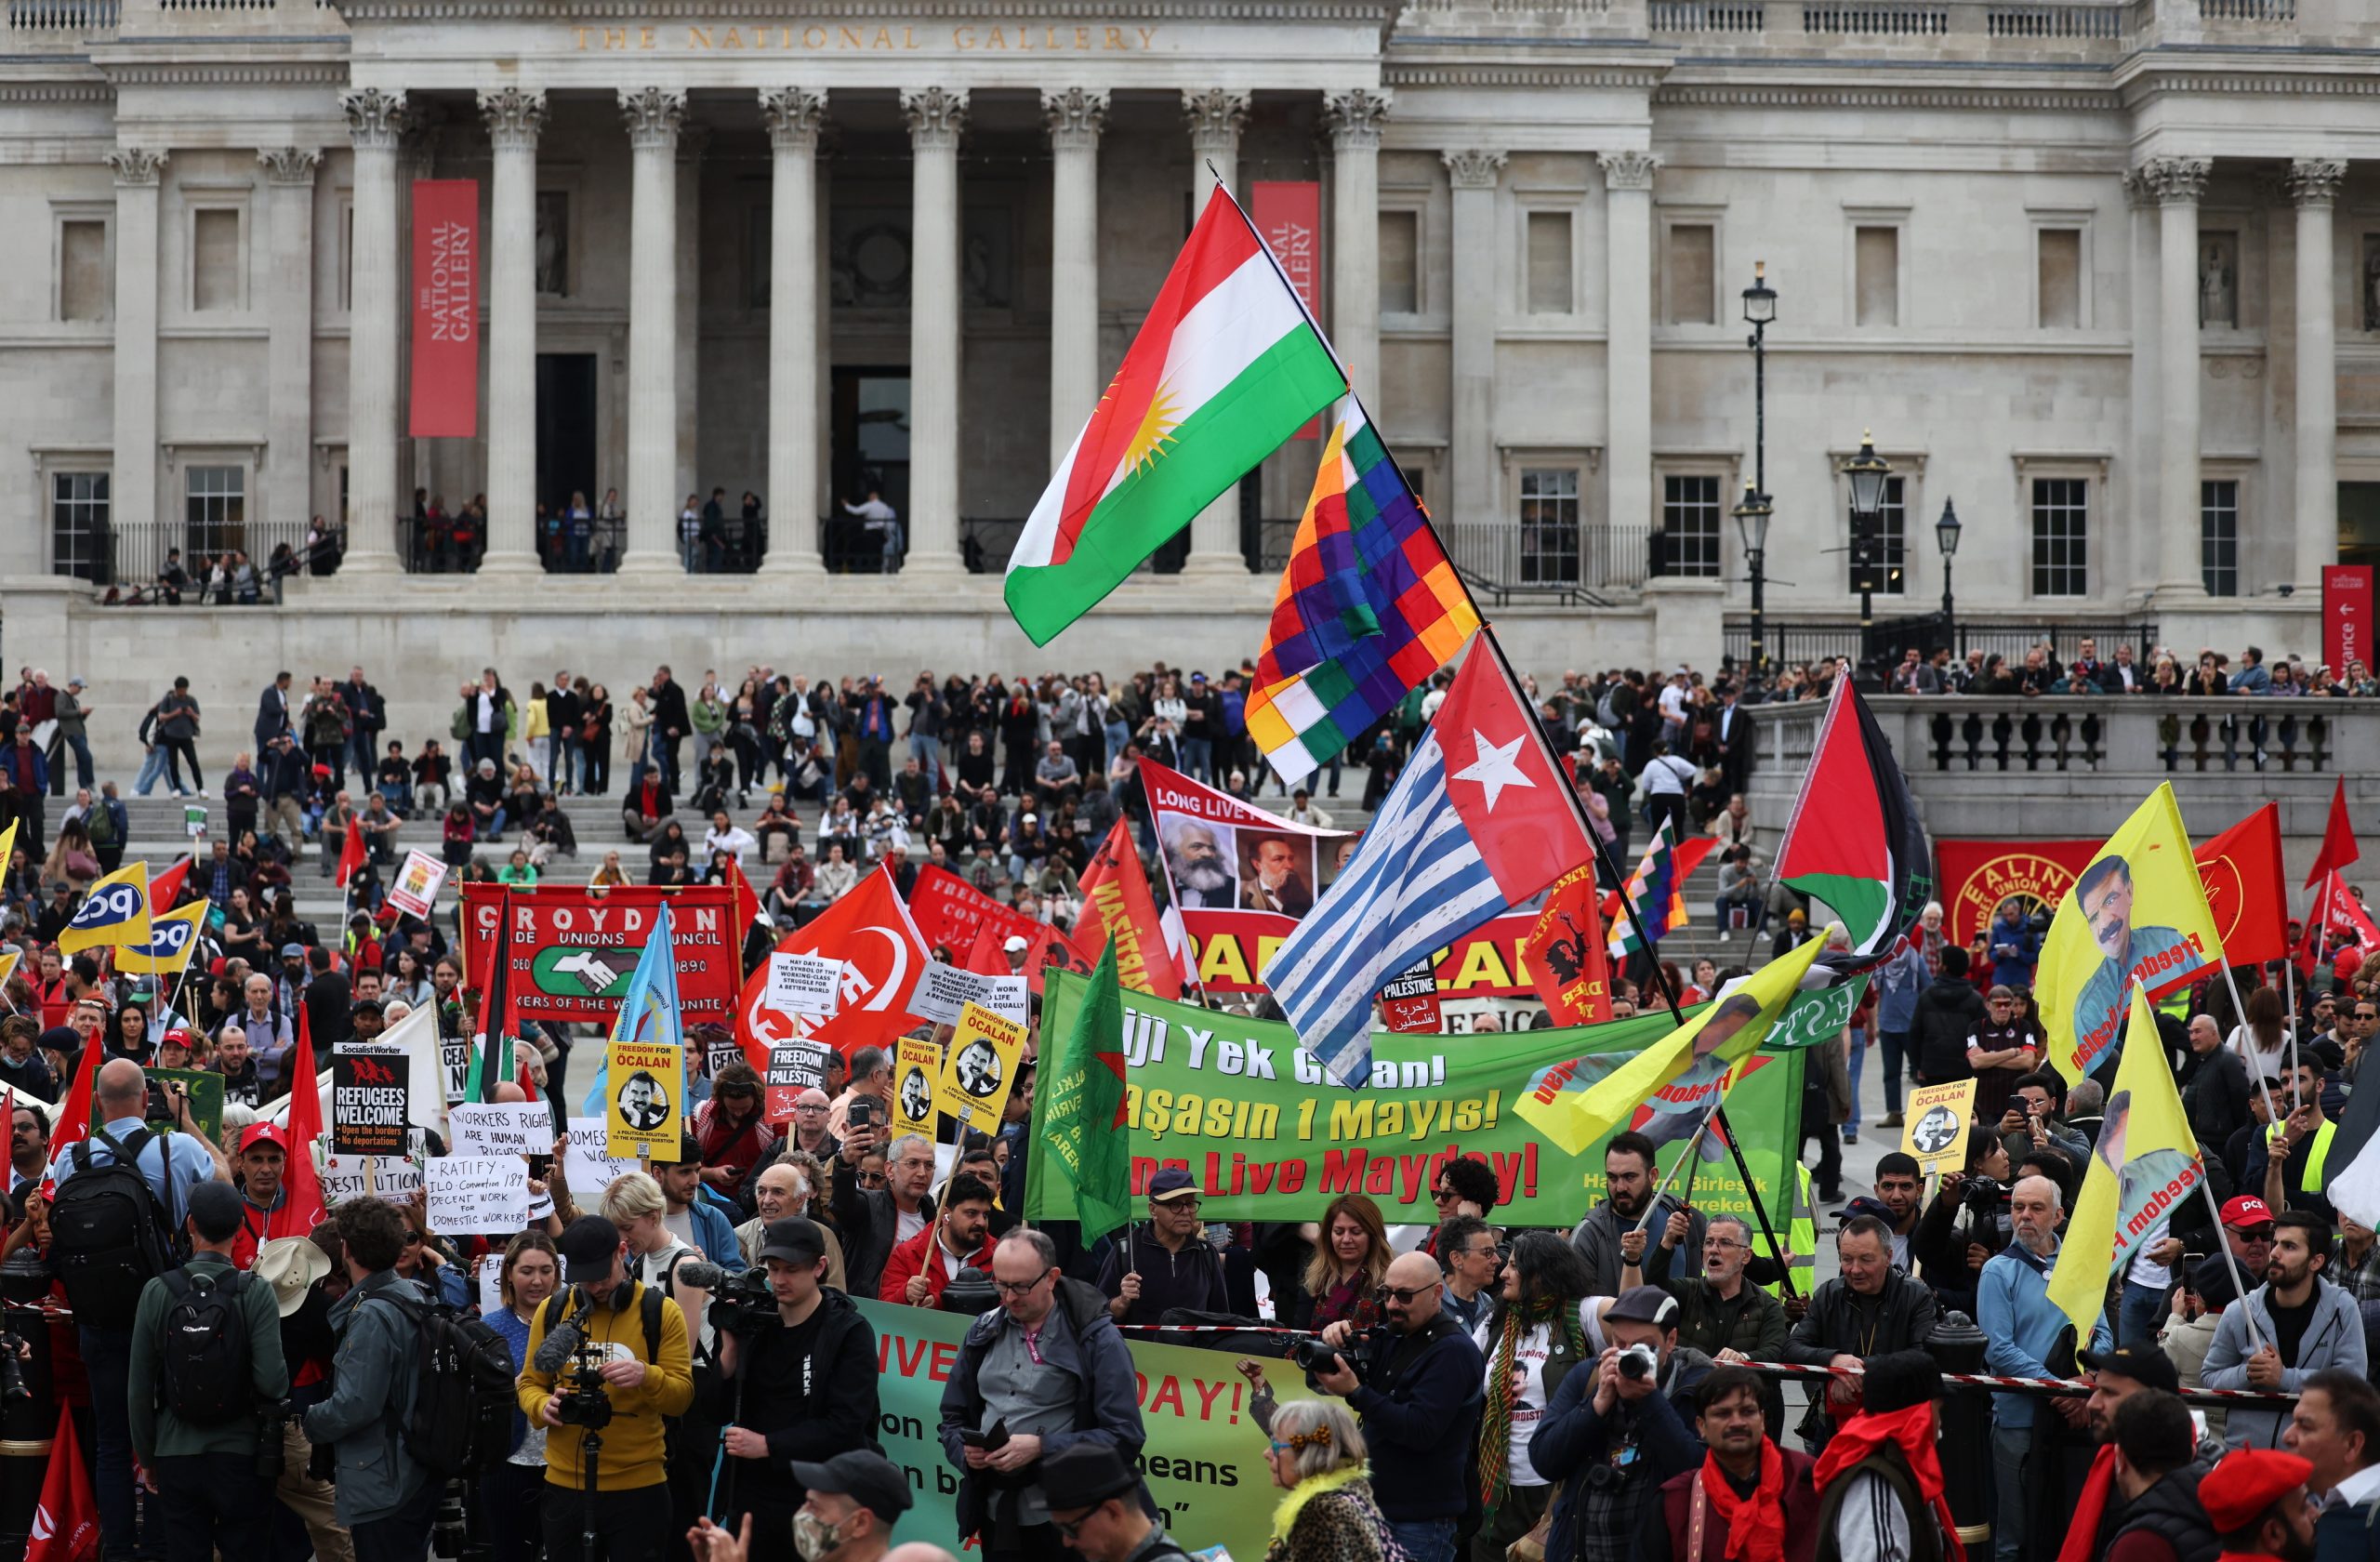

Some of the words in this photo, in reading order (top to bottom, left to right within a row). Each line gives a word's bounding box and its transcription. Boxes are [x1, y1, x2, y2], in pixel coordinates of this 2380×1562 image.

[569, 25, 656, 50] THE
[688, 25, 921, 50] NATIONAL
[951, 25, 1158, 50] GALLERY
[430, 220, 449, 341] NATIONAL
[449, 221, 470, 342] GALLERY
[2341, 623, 2355, 679] rance
[1156, 788, 1201, 812] LONG
[1964, 859, 2072, 907] EALIN
[1974, 894, 1995, 933] ADES
[1994, 878, 2042, 896] UNION
[558, 931, 625, 946] UNIONS
[675, 960, 707, 973] 1890
[789, 966, 814, 974] SYMBOL
[780, 971, 831, 982] WORKING-CLASS
[783, 977, 813, 986] STRUGGLE
[943, 970, 957, 979] MAY
[958, 973, 971, 983] DAY
[1404, 973, 1415, 982] for
[808, 986, 829, 995] WORLD
[931, 979, 983, 999] WORKING-CLASS
[931, 986, 964, 1000] STRUGGLE
[942, 976, 967, 988] SYMBOL
[976, 986, 989, 995] THE
[1383, 978, 1436, 999] PALESTINE
[555, 996, 573, 1009] OF
[579, 998, 606, 1012] THE
[931, 993, 955, 1005] BETTER
[1395, 999, 1429, 1015] الحرية
[972, 1006, 1005, 1027] FREEDOM
[1004, 1022, 1020, 1034] FOR
[1395, 1013, 1436, 1031] لفلسطين
[968, 1013, 1016, 1047] ÖCALAN
[341, 1044, 373, 1054] Socialist
[374, 1045, 401, 1055] Worker
[617, 1044, 654, 1054] FREEDOM
[654, 1047, 671, 1055] FOR
[802, 1041, 822, 1052] Worker
[903, 1040, 925, 1052] FREEDOM
[925, 1044, 935, 1053] FOR
[616, 1052, 671, 1069] ÖCALAN
[774, 1050, 823, 1068] FREEDOM
[902, 1049, 934, 1066] ÖCALAN
[1182, 1025, 1276, 1081] Yek
[1293, 1047, 1446, 1090] Gan!
[794, 1063, 803, 1071] for
[769, 1070, 824, 1090] PALESTINE
[1918, 1085, 1951, 1096] FREEDOM
[1952, 1081, 1967, 1091] FOR
[336, 1086, 405, 1107] REFUGEES
[951, 1087, 973, 1101] POLITICAL
[972, 1096, 993, 1110] SOLUTION
[1915, 1090, 1966, 1107] ÖCALAN
[336, 1105, 404, 1126] WELCOME
[451, 1111, 510, 1128] WORKERS
[519, 1112, 553, 1130] RIGHTS
[1126, 1082, 1280, 1141] aşasın
[1297, 1097, 1314, 1141] 1
[1329, 1089, 1501, 1142] Mayıs!
[341, 1125, 360, 1135] Open
[361, 1126, 373, 1135] the
[375, 1126, 402, 1136] borders
[465, 1130, 483, 1142] ARE
[490, 1132, 526, 1145] HUMAN
[565, 1130, 608, 1145] DOMES
[341, 1136, 351, 1145] No
[353, 1137, 397, 1146] deportations
[440, 1160, 496, 1177] RATIFY
[609, 1165, 621, 1176] IS
[1203, 1151, 1307, 1197] Live
[1318, 1142, 1539, 1206] Maydy!
[324, 1172, 422, 1194] DESTIUTION
[430, 1180, 453, 1194] ILO
[504, 1172, 523, 1188] 189
[1689, 1175, 1768, 1195] Birleşk
[430, 1194, 474, 1207] DECENT
[480, 1192, 509, 1202] WORK
[2241, 1198, 2264, 1212] pcs
[432, 1215, 478, 1227] DOMESTIC
[483, 1212, 527, 1225] WORKERS
[587, 1342, 614, 1353] THE
[878, 1332, 959, 1383] IVE
[1510, 1409, 1545, 1423] URDIST
